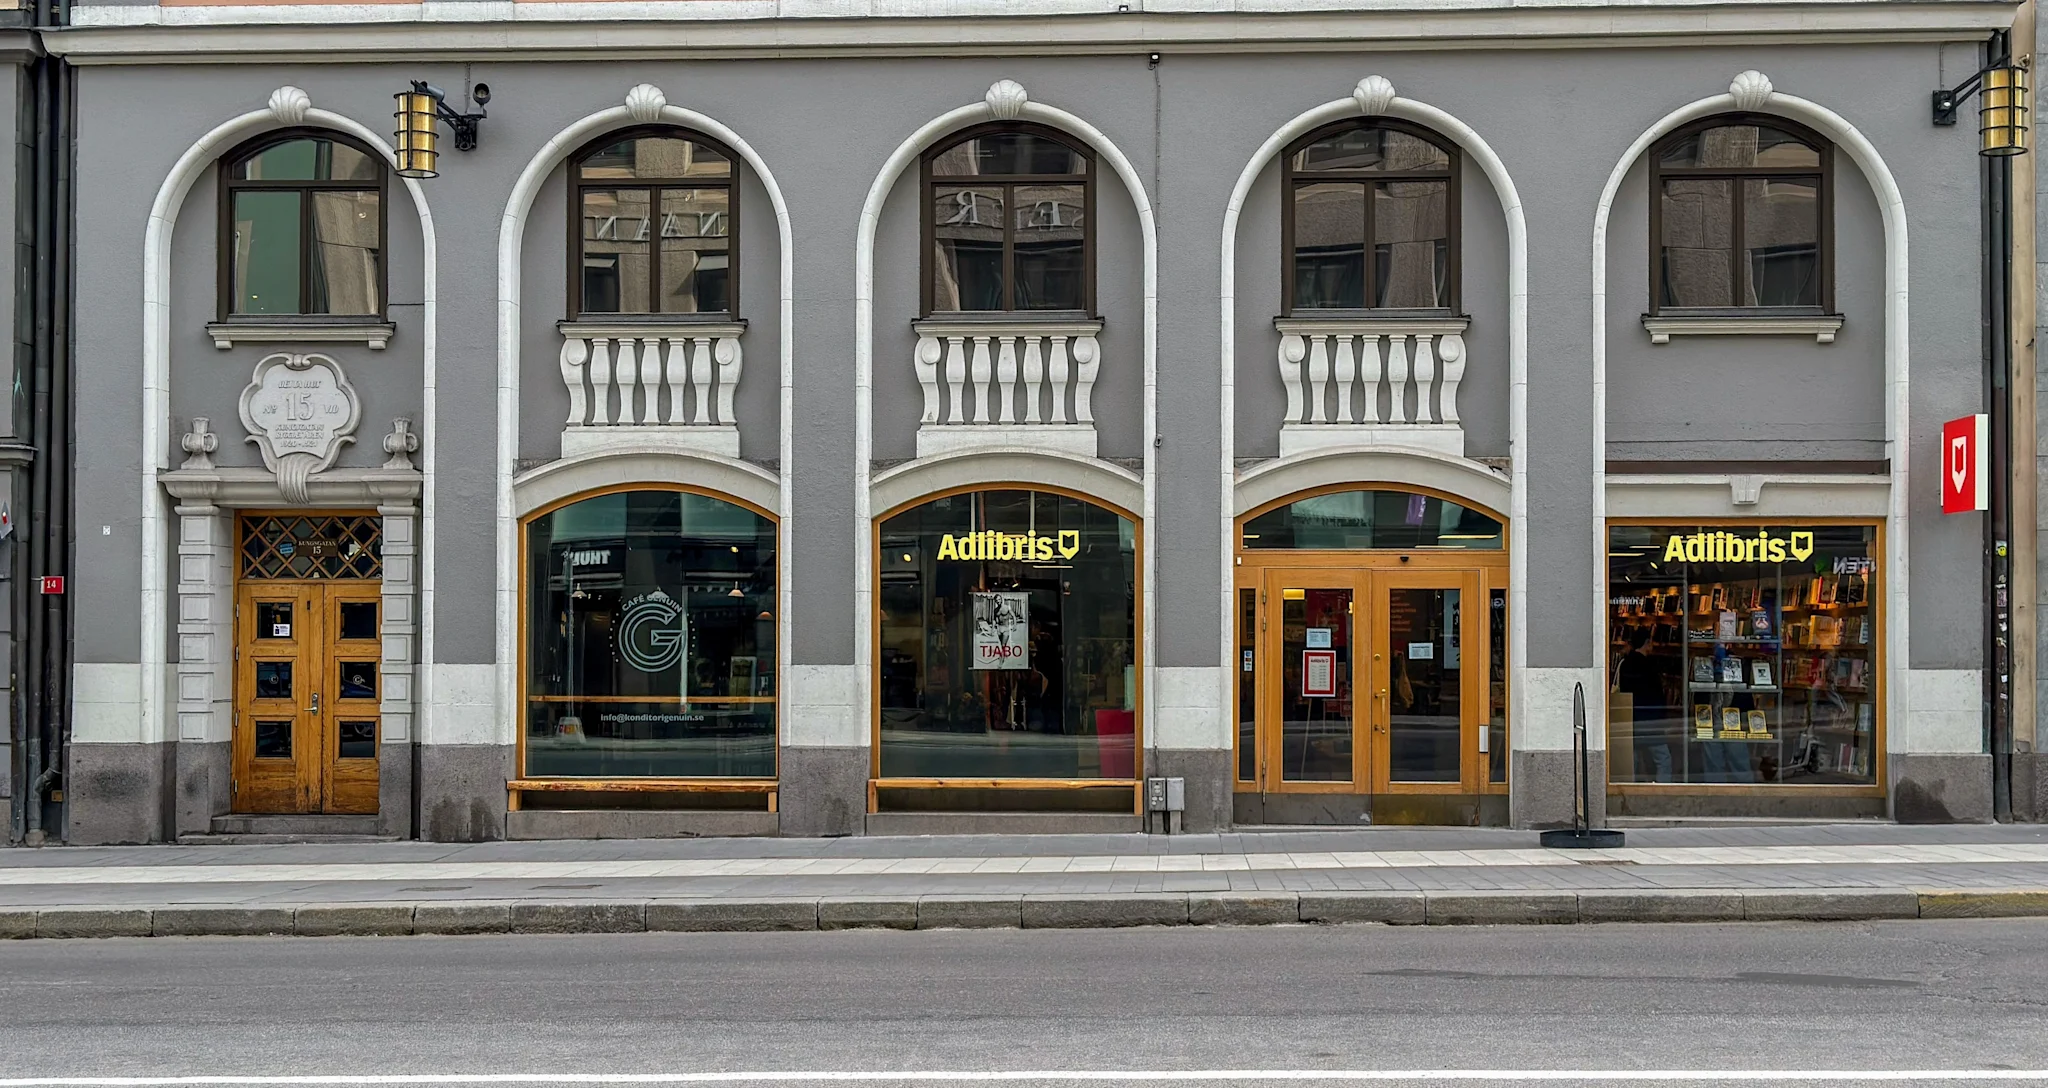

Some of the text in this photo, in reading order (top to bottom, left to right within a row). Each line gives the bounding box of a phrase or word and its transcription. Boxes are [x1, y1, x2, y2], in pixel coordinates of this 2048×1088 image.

[286, 392, 314, 421] 15
[313, 546, 322, 554] 15
[937, 529, 1053, 561] Adlibris
[1663, 530, 1786, 563] Adlibris
[46, 580, 56, 588] 14
[621, 594, 683, 613] CAFÉ GENUIN
[980, 645, 1023, 658] TJABO
[600, 713, 705, 723] info@konditorigenuin.se
